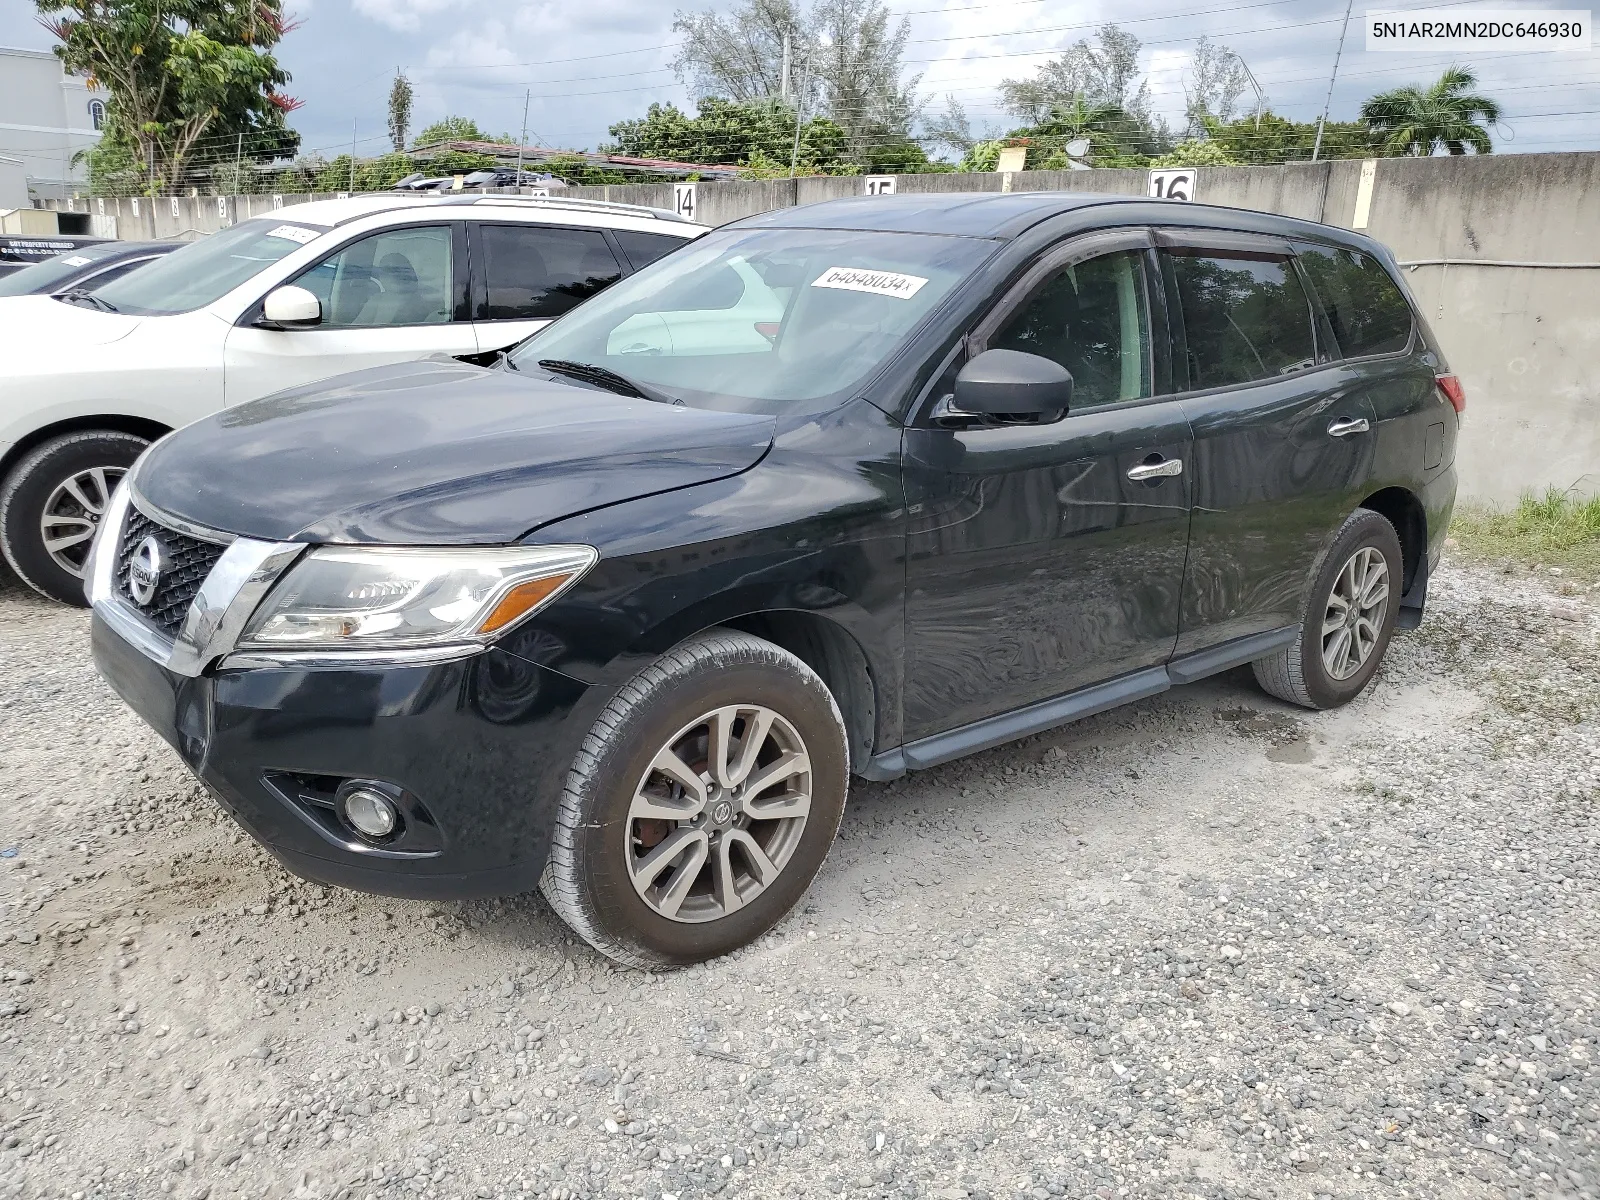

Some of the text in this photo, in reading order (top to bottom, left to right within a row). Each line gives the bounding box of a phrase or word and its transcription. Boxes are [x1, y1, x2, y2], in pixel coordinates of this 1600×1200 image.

[1154, 175, 1189, 200] 16
[172, 199, 179, 215] 8
[219, 199, 225, 216] 9
[676, 188, 694, 216] 14
